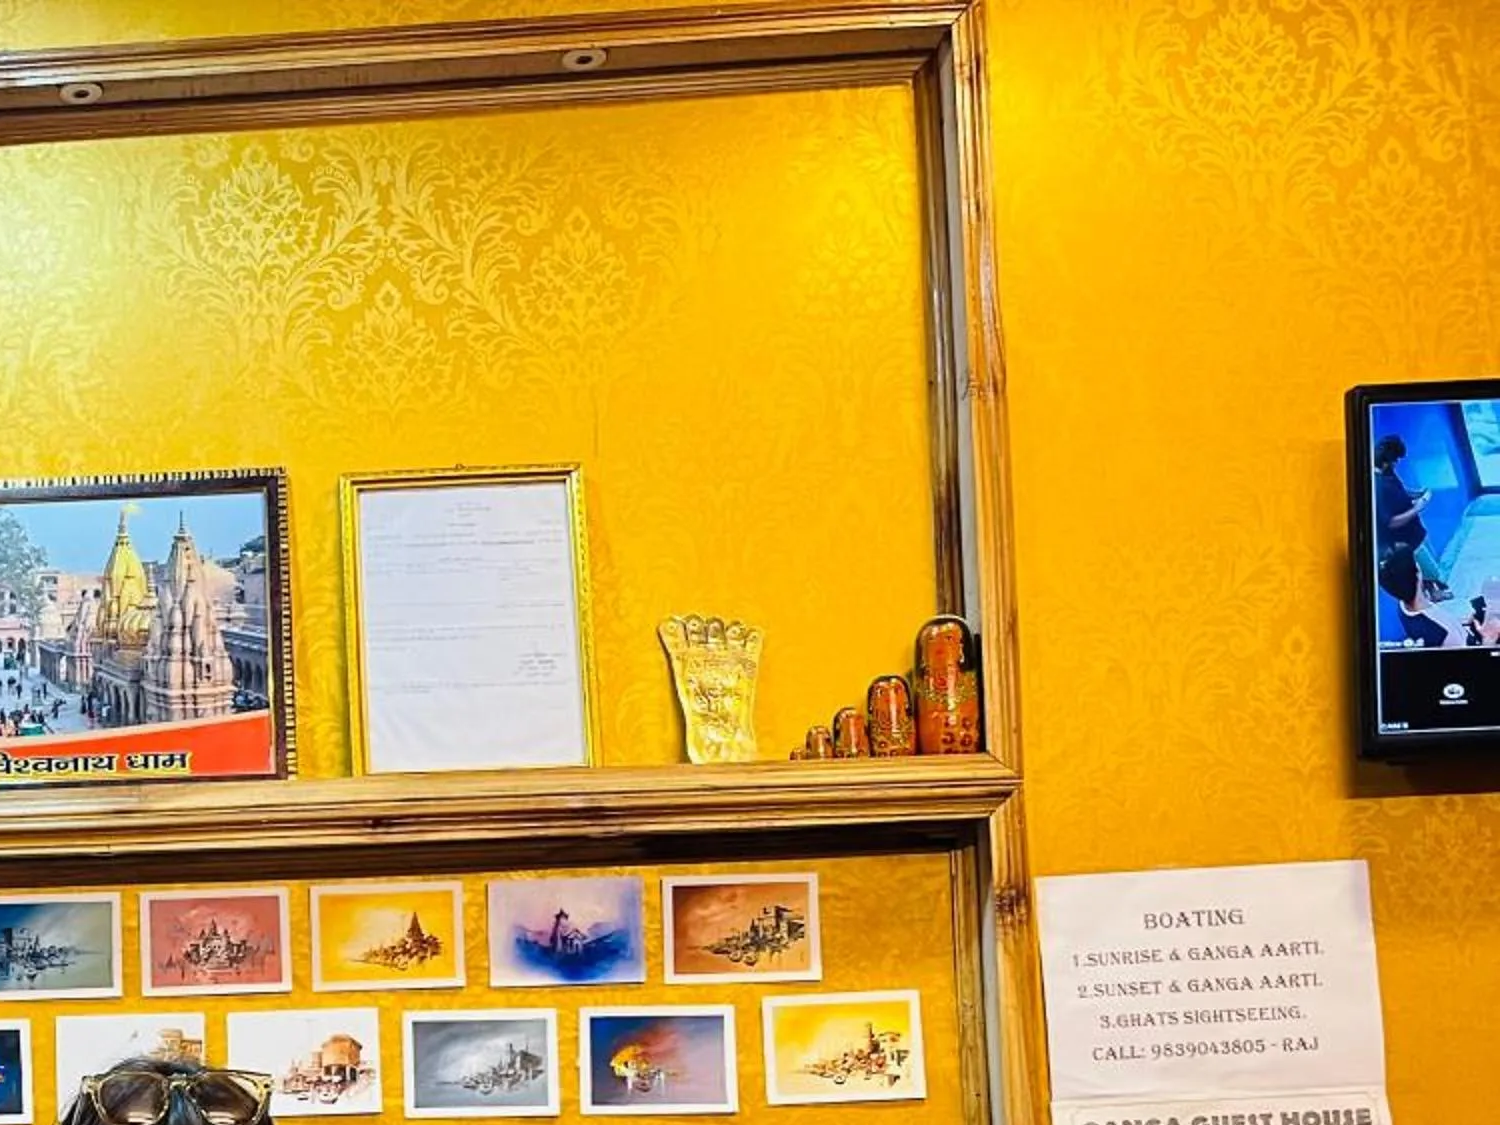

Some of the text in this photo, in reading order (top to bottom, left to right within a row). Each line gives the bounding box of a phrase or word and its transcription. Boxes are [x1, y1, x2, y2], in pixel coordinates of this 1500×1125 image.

[125, 751, 188, 772] धाम
[1144, 909, 1245, 929] BOATING
[1073, 950, 1163, 967] 1.SUNRISE
[1169, 948, 1181, 962] &
[1188, 944, 1254, 961] GANGA
[1078, 981, 1162, 999] 2.SUNSET
[1169, 980, 1182, 994] &
[1187, 977, 1253, 993] GANGA
[1100, 1006, 1307, 1029] 3.GHATS SIGHTSEEING.
[1092, 1046, 1146, 1062] CALL:
[1151, 1039, 1266, 1059] 9839043805
[1282, 1037, 1319, 1051] RAJ
